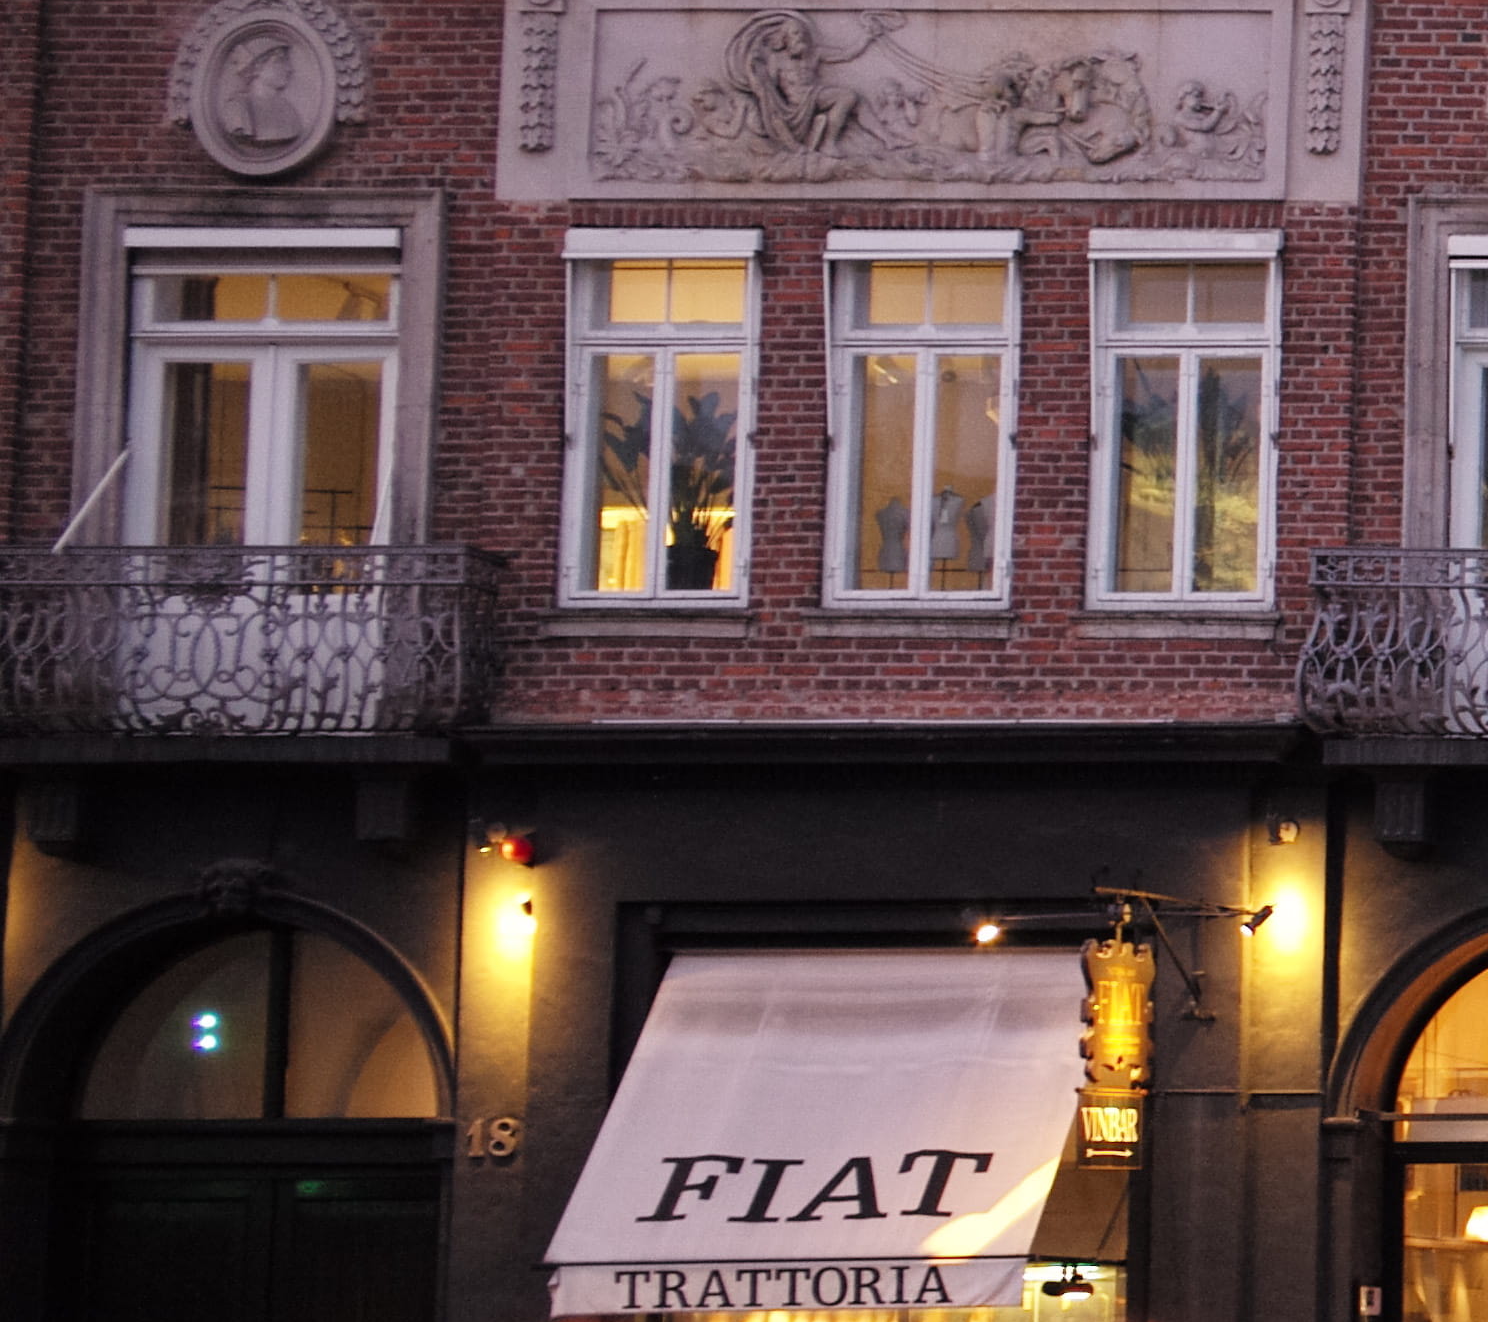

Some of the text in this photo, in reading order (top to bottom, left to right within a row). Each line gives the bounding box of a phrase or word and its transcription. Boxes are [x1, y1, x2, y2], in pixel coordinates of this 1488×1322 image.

[1097, 980, 1145, 1025] FIAT
[466, 1117, 523, 1157] 18
[1080, 1107, 1139, 1144] VINBAR
[635, 1149, 993, 1223] FIAT
[614, 1265, 951, 1310] TRATTORIA
